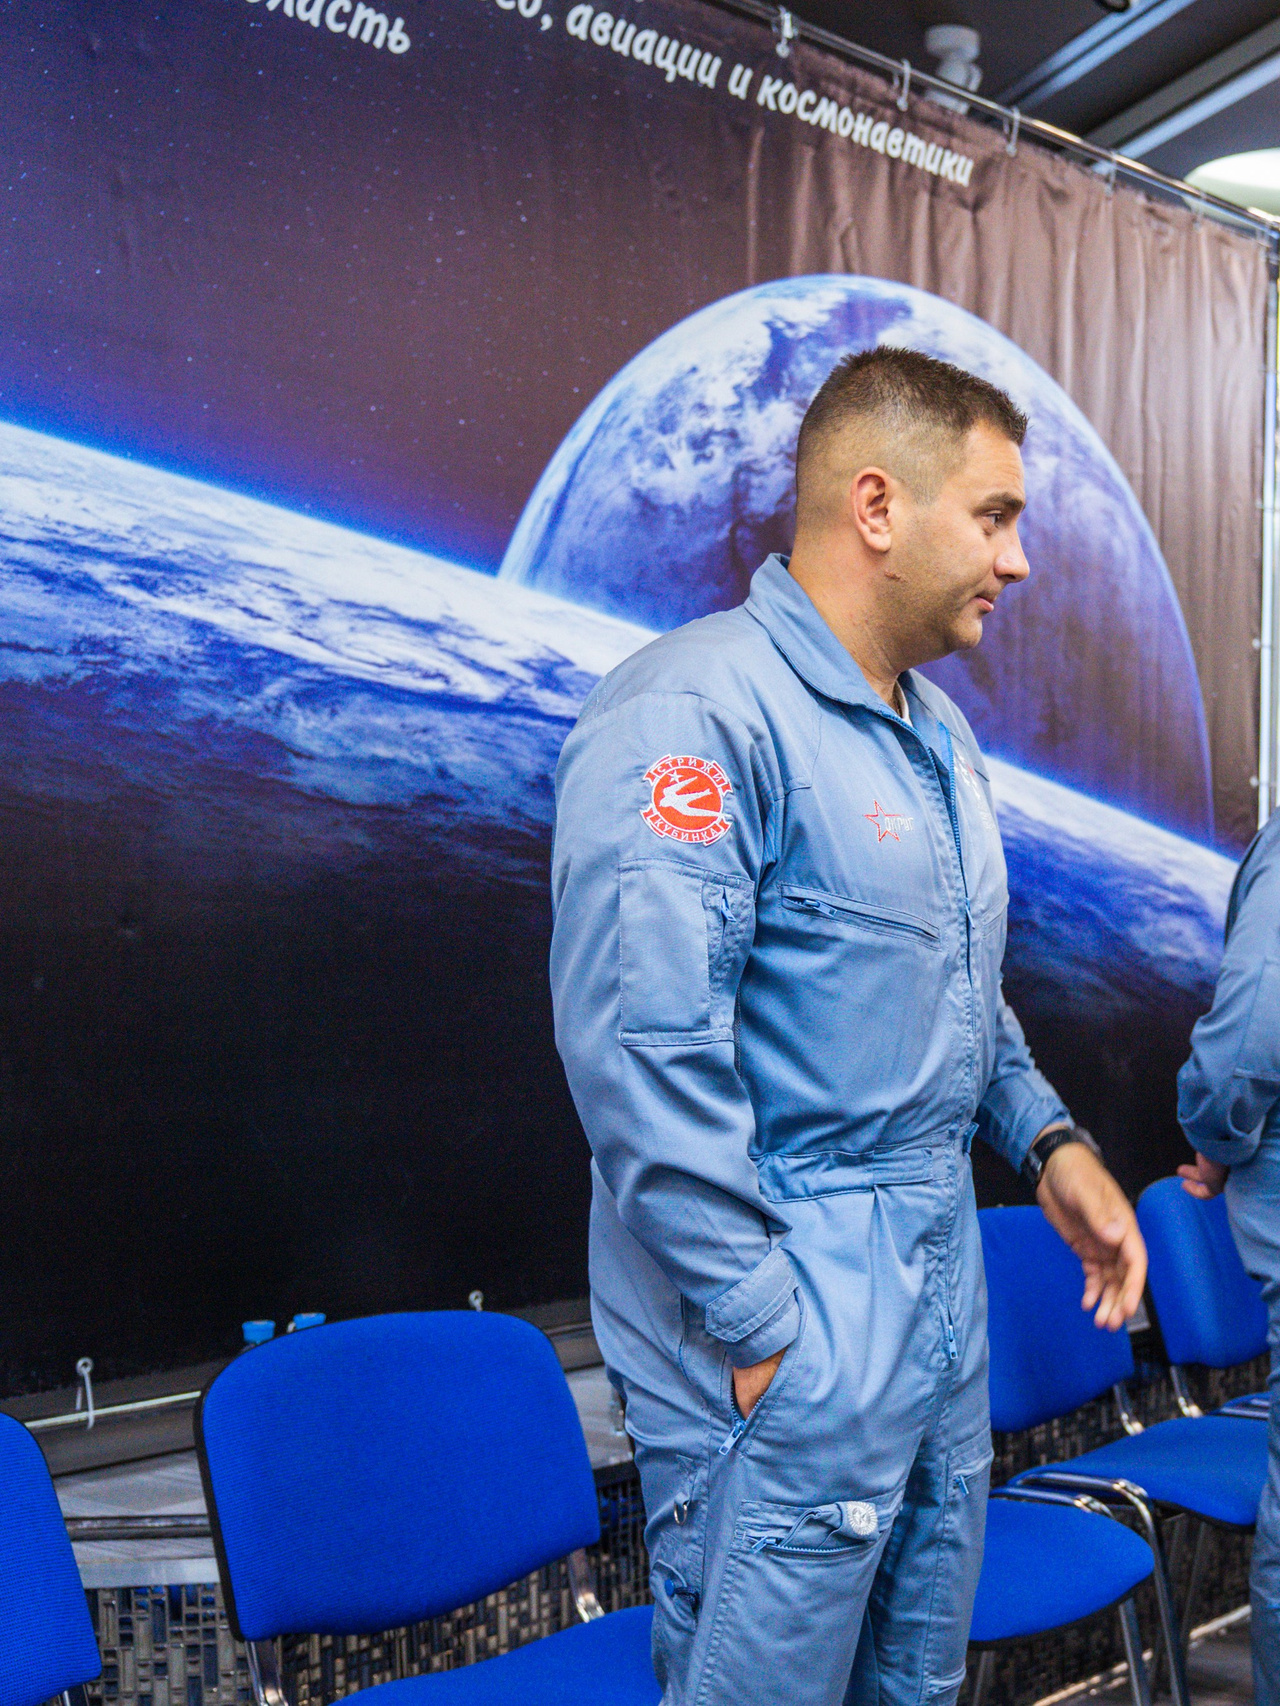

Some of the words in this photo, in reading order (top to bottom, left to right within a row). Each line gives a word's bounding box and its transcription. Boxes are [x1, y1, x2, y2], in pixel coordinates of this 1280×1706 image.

[246, 0, 411, 54] ласть
[566, 3, 722, 89] авиации
[728, 63, 753, 100] и
[756, 74, 975, 187] космонавтики
[656, 757, 722, 784] СТРИЖИ
[653, 818, 718, 841] КУБИНКА
